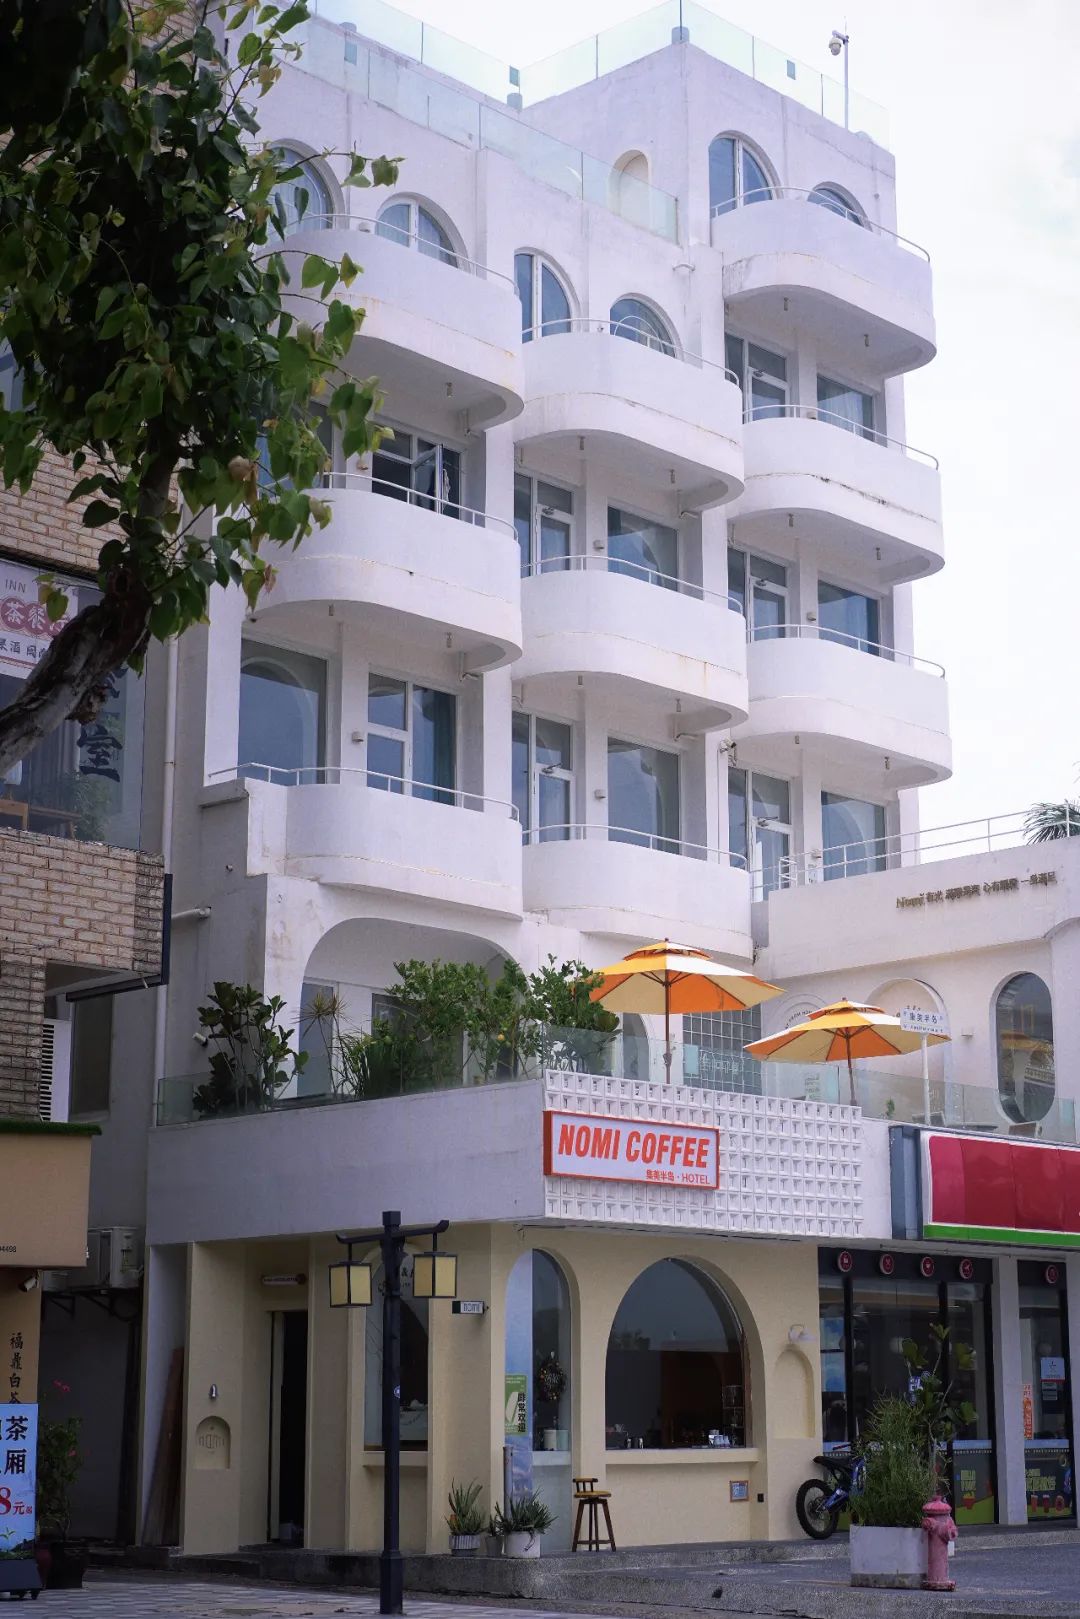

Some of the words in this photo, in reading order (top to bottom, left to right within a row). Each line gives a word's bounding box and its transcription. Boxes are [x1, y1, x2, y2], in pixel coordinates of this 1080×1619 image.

[5, 579, 26, 593] INN
[4, 600, 67, 632] 茶餐
[558, 1123, 621, 1160] NOMI
[625, 1130, 711, 1169] COFFEE
[681, 1173, 711, 1185] HOTEL
[0, 1415, 29, 1441] 茶
